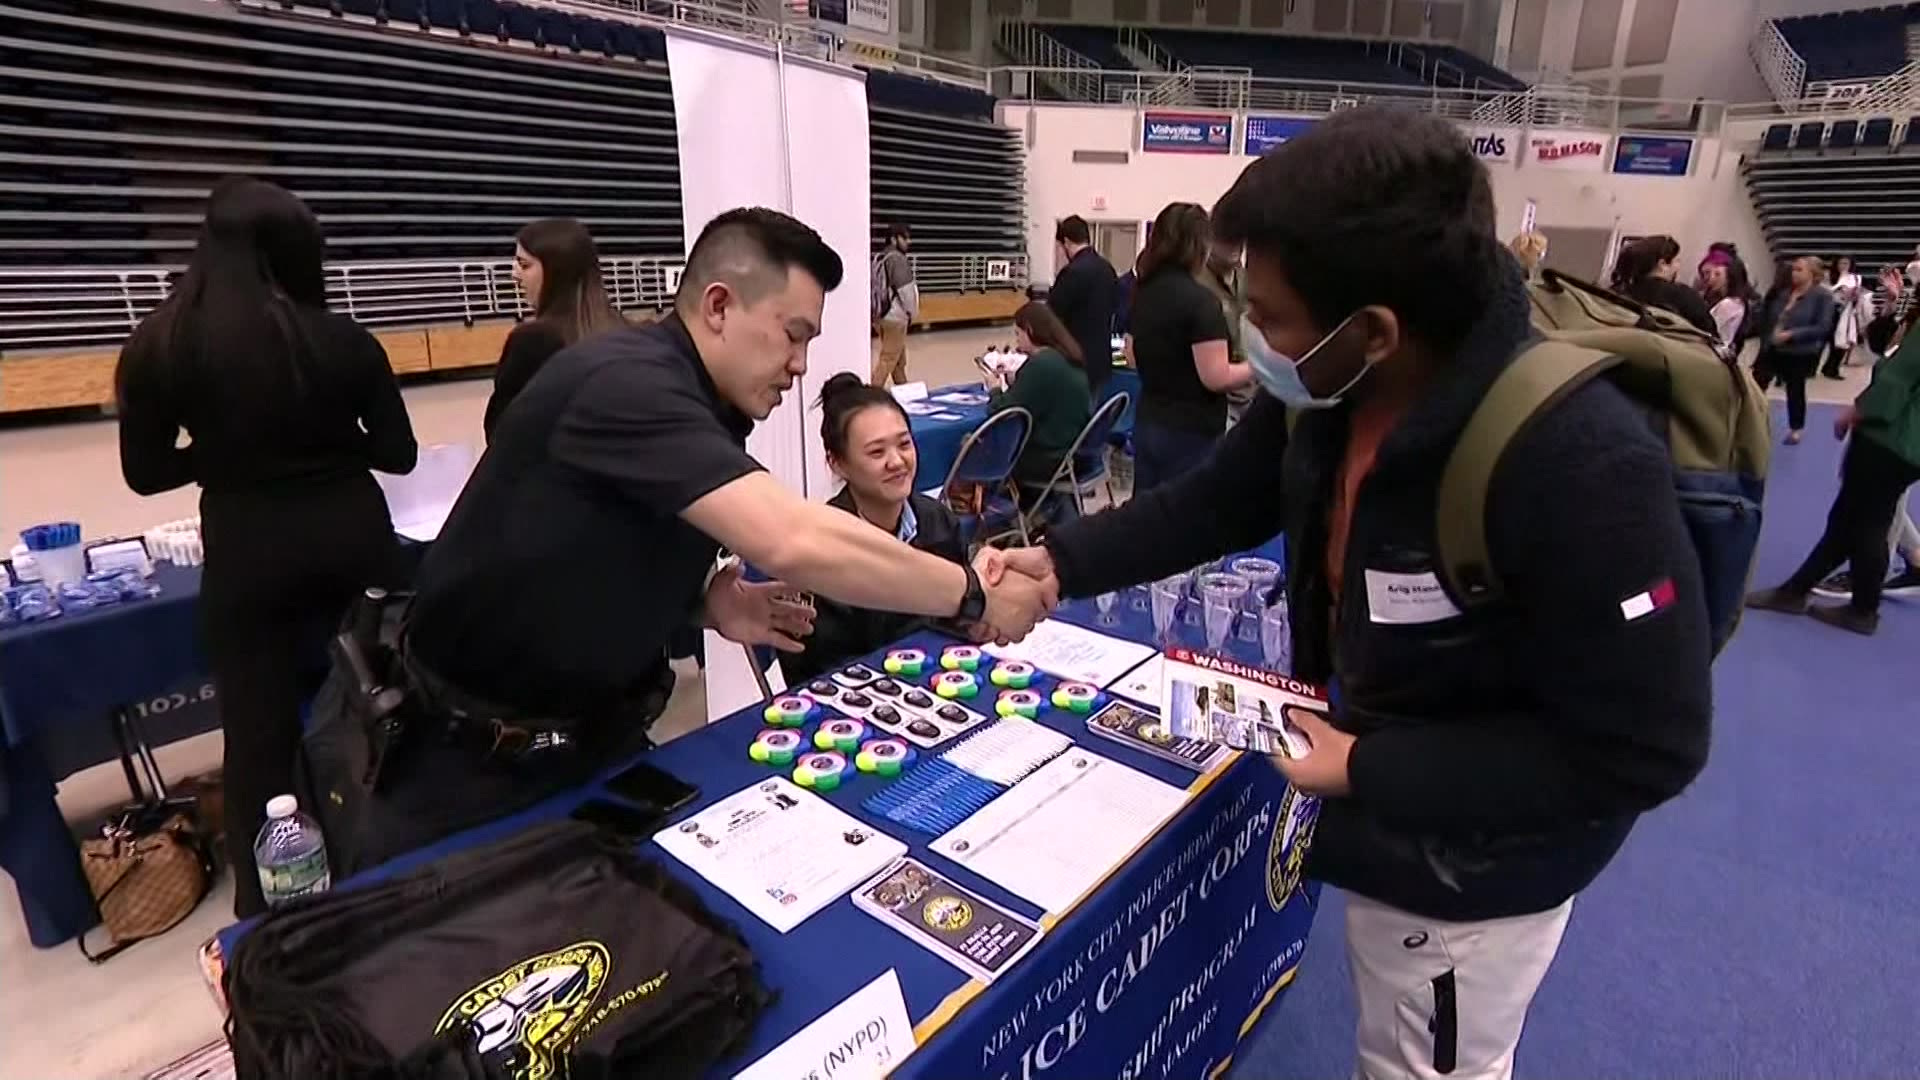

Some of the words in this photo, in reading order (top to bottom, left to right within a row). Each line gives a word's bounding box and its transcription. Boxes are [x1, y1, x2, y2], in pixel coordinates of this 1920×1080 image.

[1150, 124, 1202, 136] Valvoline
[1191, 652, 1317, 697] WASHINGTON
[982, 1003, 1030, 1071] NEW
[1034, 952, 1085, 1012] YORK
[1087, 913, 1125, 962] CITY
[1127, 861, 1176, 927] POLICE
[1000, 997, 1087, 1080] ICE
[1095, 881, 1195, 1014] CADET
[1199, 799, 1272, 900] CORPS
[1168, 902, 1257, 1026] PROGRAM
[459, 965, 527, 1016] CADET
[823, 1015, 888, 1080] (NYPD)
